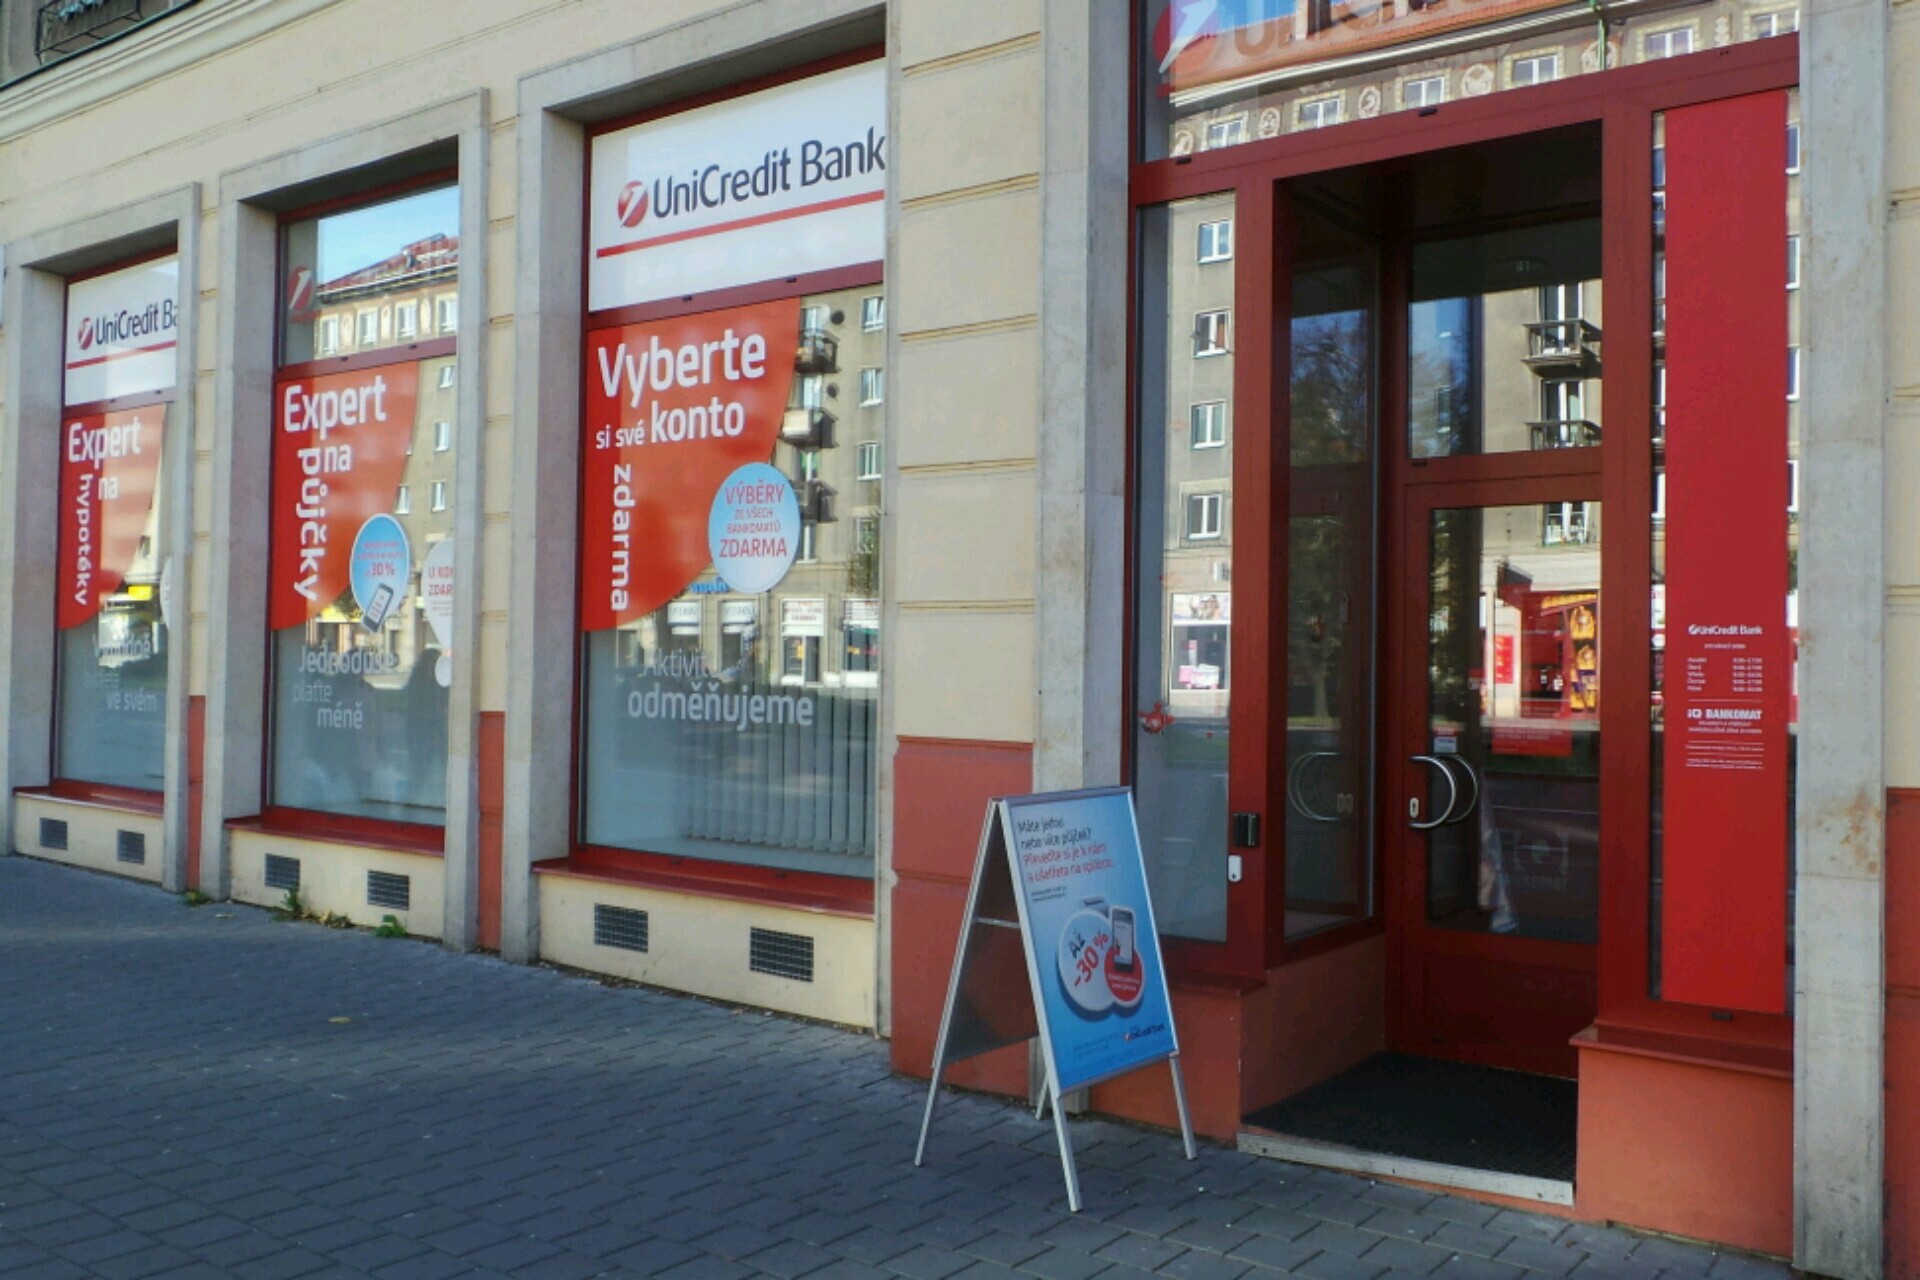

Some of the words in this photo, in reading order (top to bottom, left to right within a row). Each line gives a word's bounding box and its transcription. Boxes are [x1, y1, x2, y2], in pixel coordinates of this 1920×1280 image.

[654, 147, 790, 218] UniCredit
[801, 126, 885, 186] Bank
[96, 302, 158, 344] UniCredit
[598, 328, 766, 408] Vyberte
[284, 375, 386, 440] Expert
[595, 424, 611, 449] si
[615, 419, 645, 448] své
[651, 396, 744, 443] konto
[68, 416, 142, 469] Expert
[324, 444, 352, 473] na
[98, 476, 119, 500] na
[725, 478, 785, 505] VÝBĚRY
[75, 473, 92, 605] hypotéky
[294, 447, 327, 601] půjčky
[611, 463, 635, 611] zdarma
[719, 537, 787, 558] ZDARMA
[299, 643, 399, 674] Jednoduše
[317, 701, 363, 729] méně
[628, 682, 814, 731] odměňujeme
[1706, 708, 1762, 720] BANKOMAT
